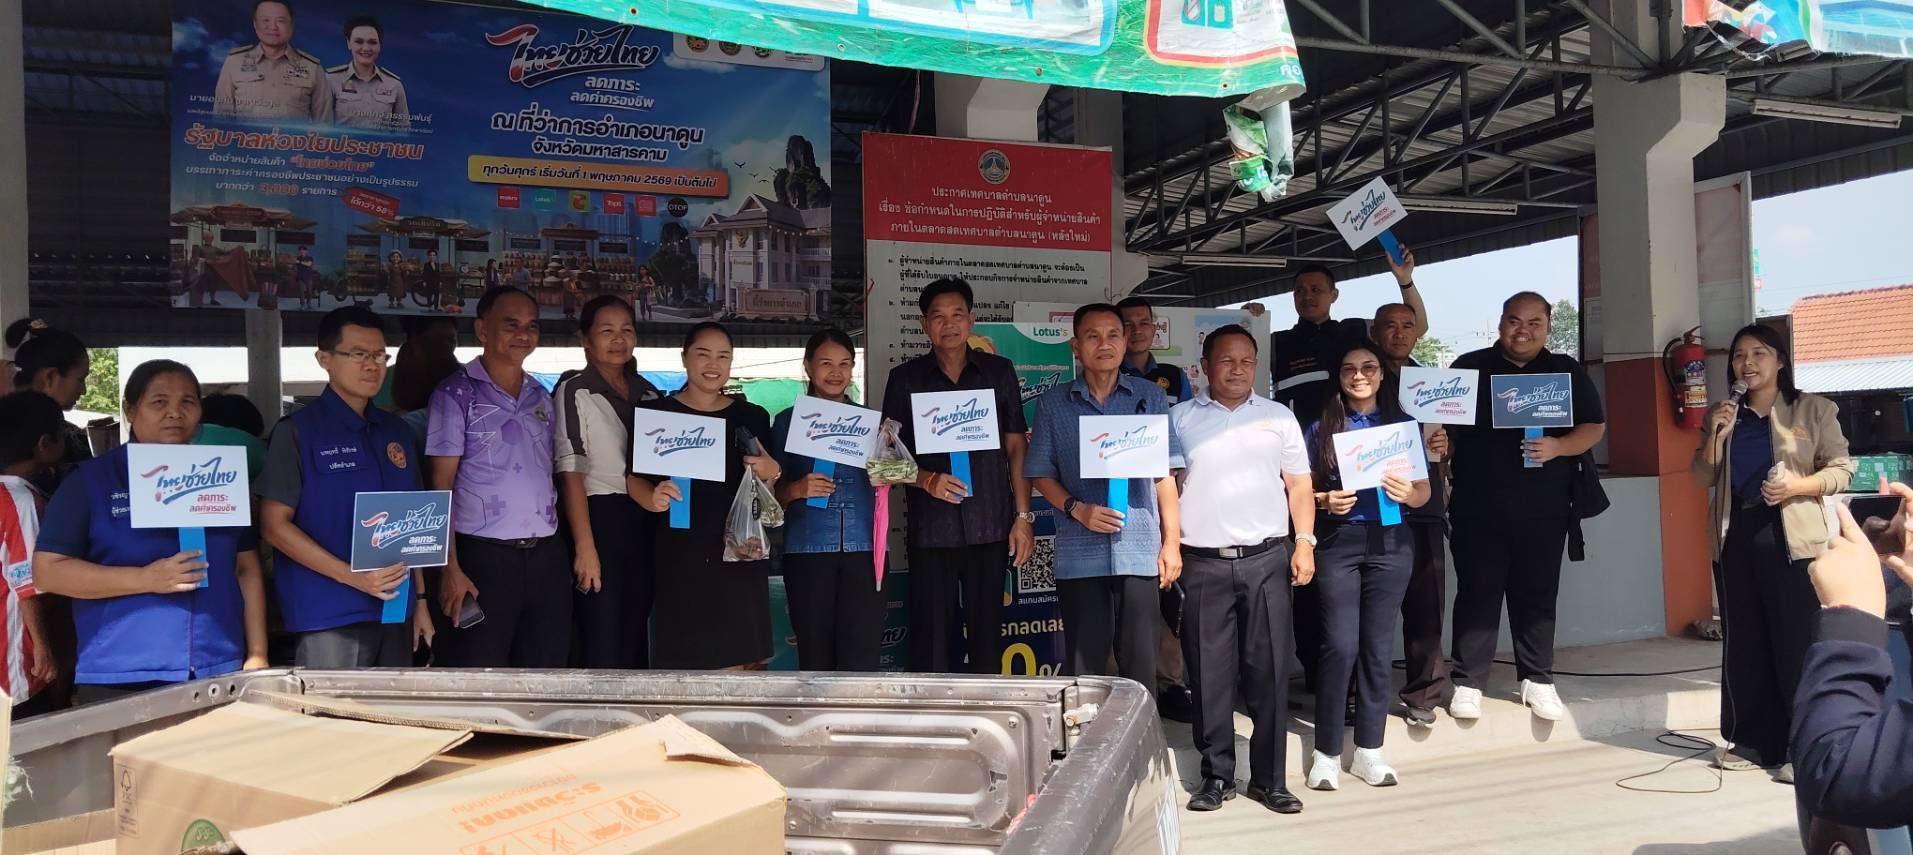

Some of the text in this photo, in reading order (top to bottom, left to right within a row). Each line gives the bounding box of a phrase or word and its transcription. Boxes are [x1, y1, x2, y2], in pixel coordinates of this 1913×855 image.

[485, 24, 660, 88] ไทยช่วยไทย
[584, 75, 640, 91] ลดภาระ
[570, 91, 654, 108] ลดค่าครองชีพ
[491, 102, 704, 150] ณ ที่ว่าการอำเภอนาดูน
[185, 121, 424, 160] รัฐบาลห่วงใยประชาชน
[531, 137, 668, 162] จังหวัดมหาสารคาม
[483, 162, 717, 188] ทุกวันศุกร์ เริ่มวันที่ 1 พฤษภาคม 2569 เป็นต้นไป
[302, 187, 337, 196] รายการ
[932, 186, 1052, 207] ประกาศเทศบาลตำบลนาดูน
[668, 203, 688, 212] OTOP
[879, 197, 900, 213] เรื่อง
[900, 283, 923, 293] ตำบลน
[900, 326, 924, 334] ตำบลน
[1033, 327, 1068, 337] Lotus's
[1407, 377, 1470, 408] ไทยช่วยไทย
[1496, 381, 1570, 414] ไทยช่วยไทย
[801, 412, 870, 441] ไทยช่วยไทย
[921, 397, 989, 436] ไทยช่วยไทย
[645, 426, 716, 457] ไทยช่วยไทย
[141, 456, 237, 505] ไทยช่วยไทย
[197, 494, 229, 503] ลดภาระ
[360, 502, 448, 550] ไทยช่วยไทย
[408, 535, 437, 544] ลดภาระ
